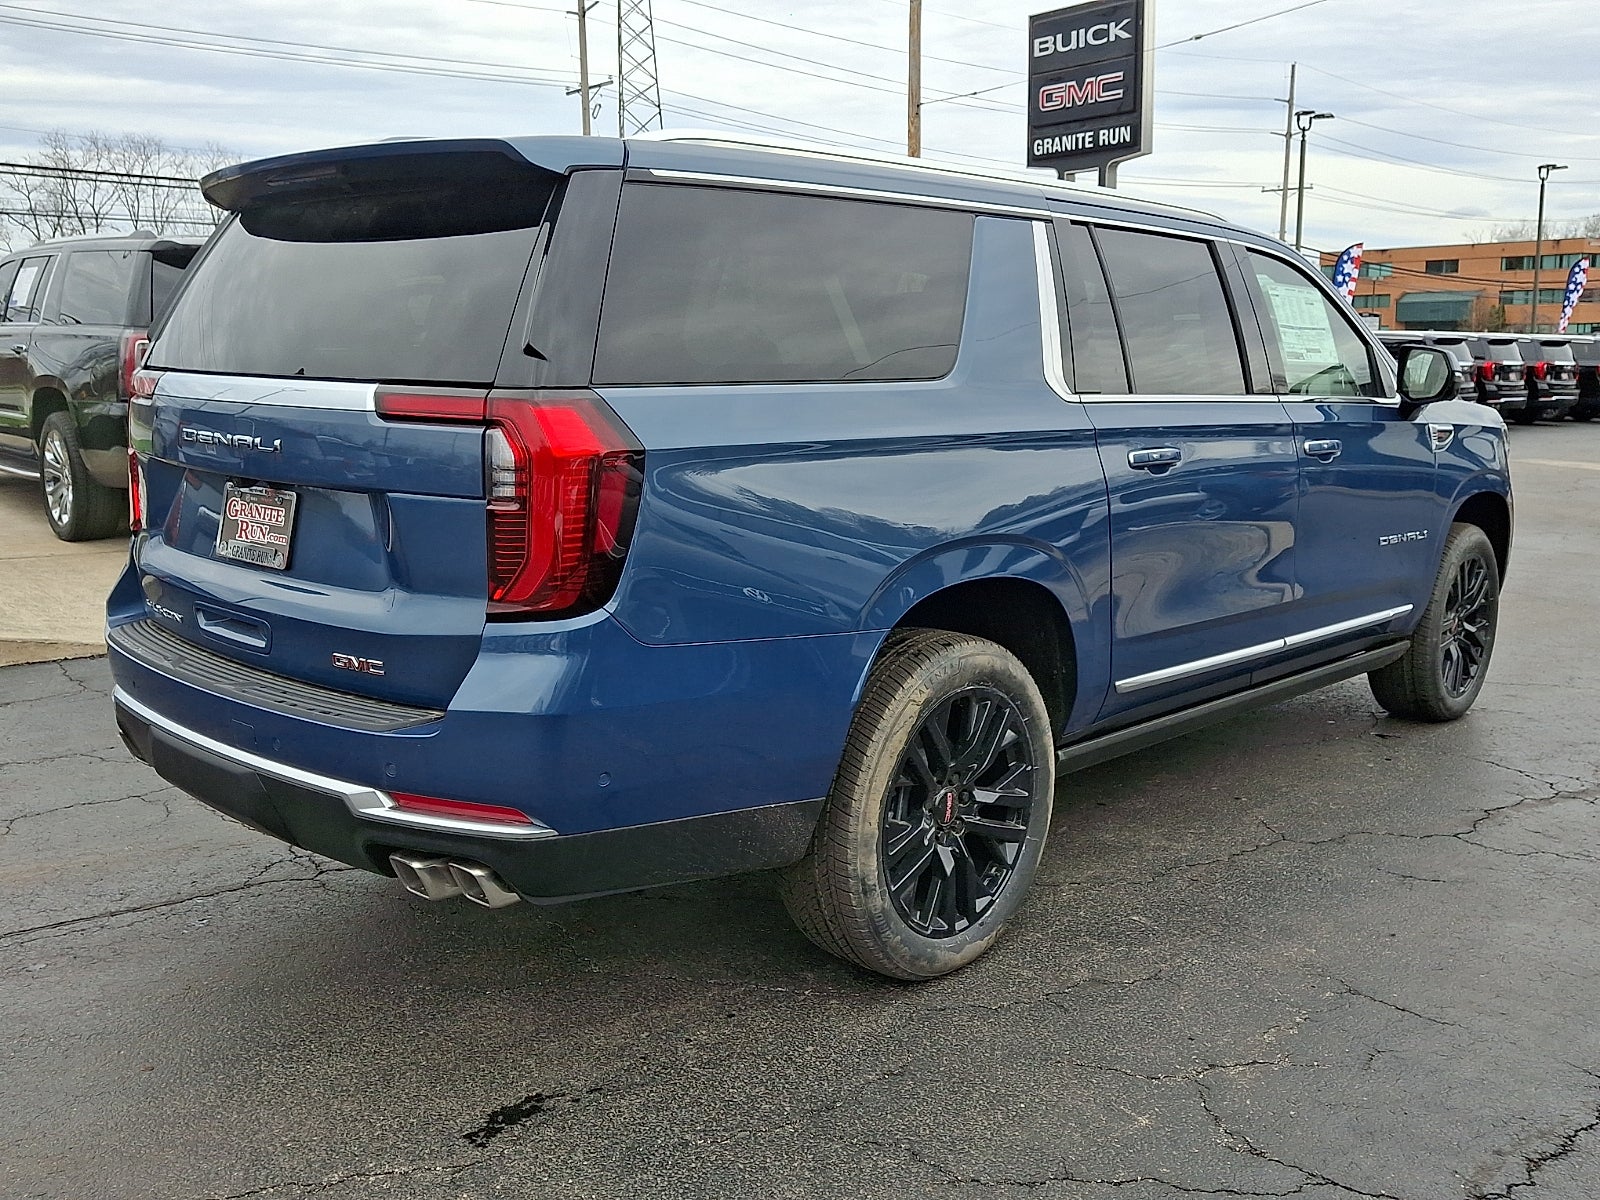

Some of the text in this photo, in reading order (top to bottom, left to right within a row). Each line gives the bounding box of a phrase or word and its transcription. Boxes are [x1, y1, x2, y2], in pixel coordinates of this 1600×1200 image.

[1033, 18, 1132, 57] BUICK
[1039, 71, 1124, 112] GMC
[1033, 126, 1131, 156] GRANITE RUN
[182, 427, 282, 453] DENALI
[227, 497, 285, 527] GRANITE
[1379, 529, 1428, 546] DENALI
[332, 652, 384, 676] GMC
